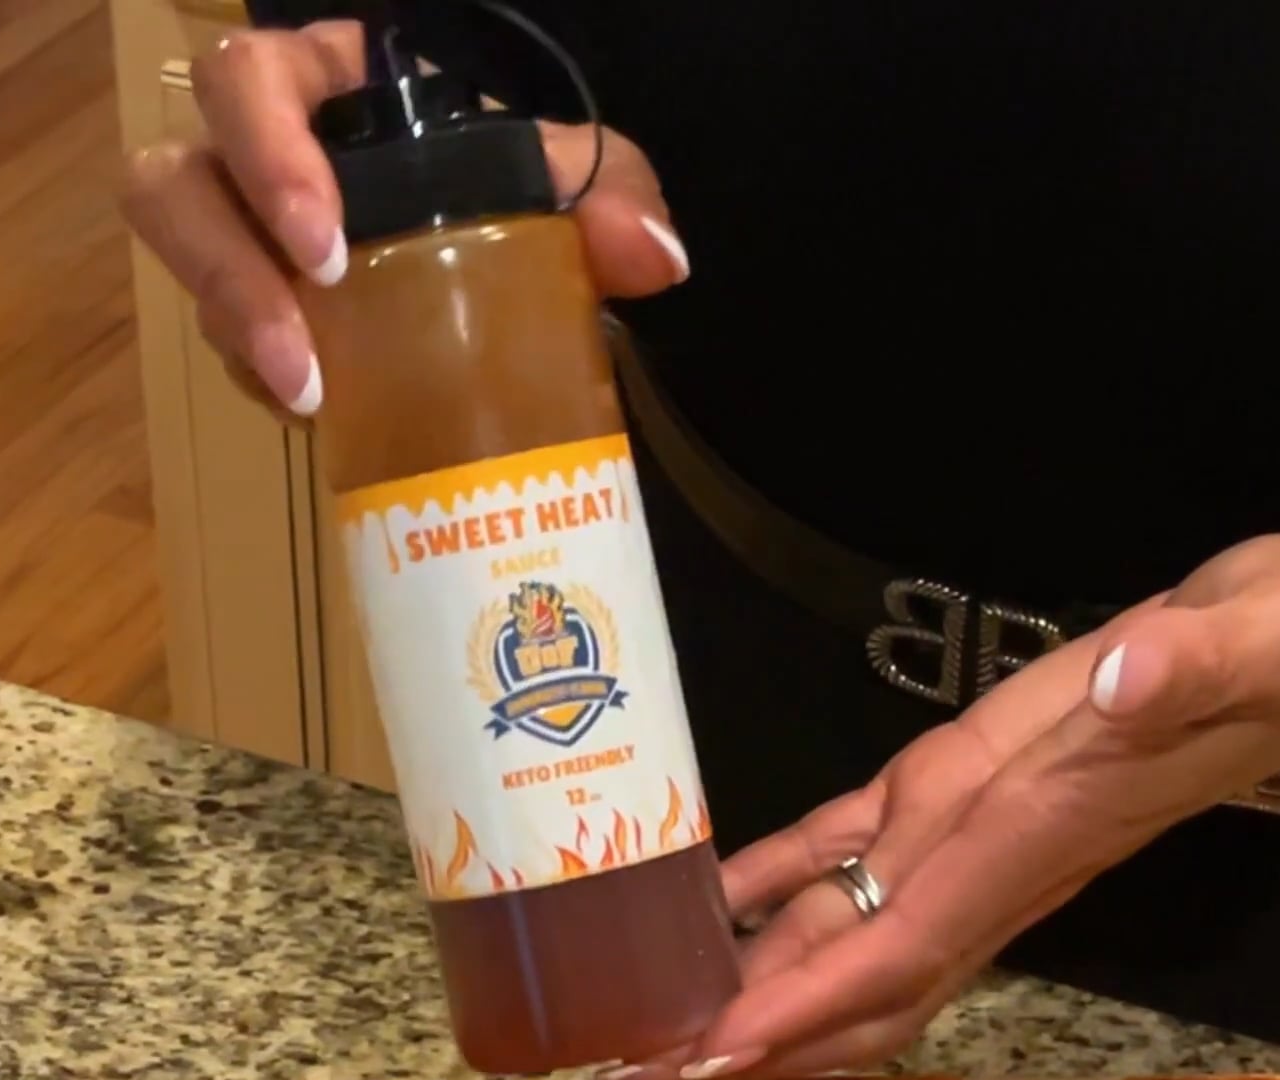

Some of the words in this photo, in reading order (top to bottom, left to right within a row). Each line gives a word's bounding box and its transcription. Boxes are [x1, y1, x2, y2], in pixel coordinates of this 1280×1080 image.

[405, 507, 525, 562] SWEET
[536, 487, 613, 533] HEAT
[490, 547, 561, 579] SAUCE
[502, 766, 551, 790] KETO
[554, 744, 636, 778] FRIENDLY
